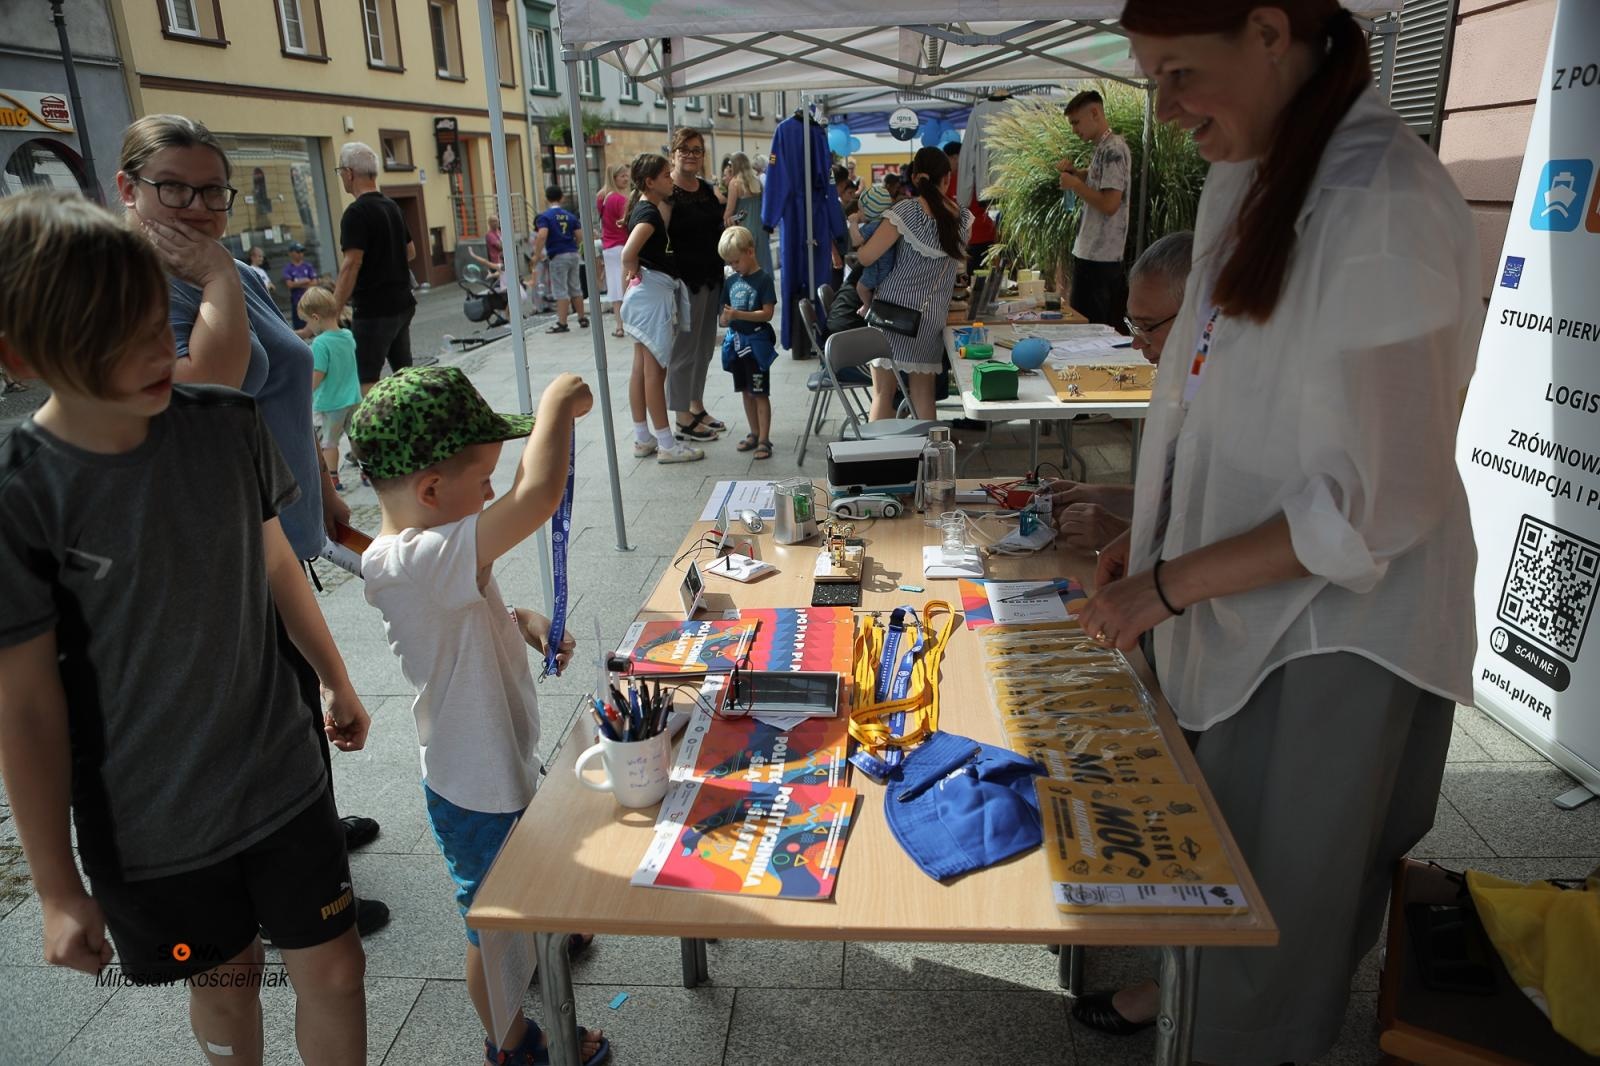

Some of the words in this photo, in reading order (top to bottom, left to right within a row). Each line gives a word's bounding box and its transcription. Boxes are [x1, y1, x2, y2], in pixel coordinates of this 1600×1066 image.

[1552, 68, 1566, 90] Z
[1568, 63, 1600, 89] PO
[1500, 309, 1554, 334] STUDIA
[1471, 447, 1571, 499] KONSUMPCJA
[1576, 485, 1583, 502] I
[1586, 489, 1600, 510] P
[1514, 644, 1540, 666] SCAN
[1481, 668, 1552, 721] polsl.pl/RFR
[729, 807, 768, 861] ŚLĄSKA
[743, 786, 794, 887] POLITECHNIKA
[1090, 801, 1152, 868] MOC
[1142, 809, 1177, 861] ŚLĄSKA
